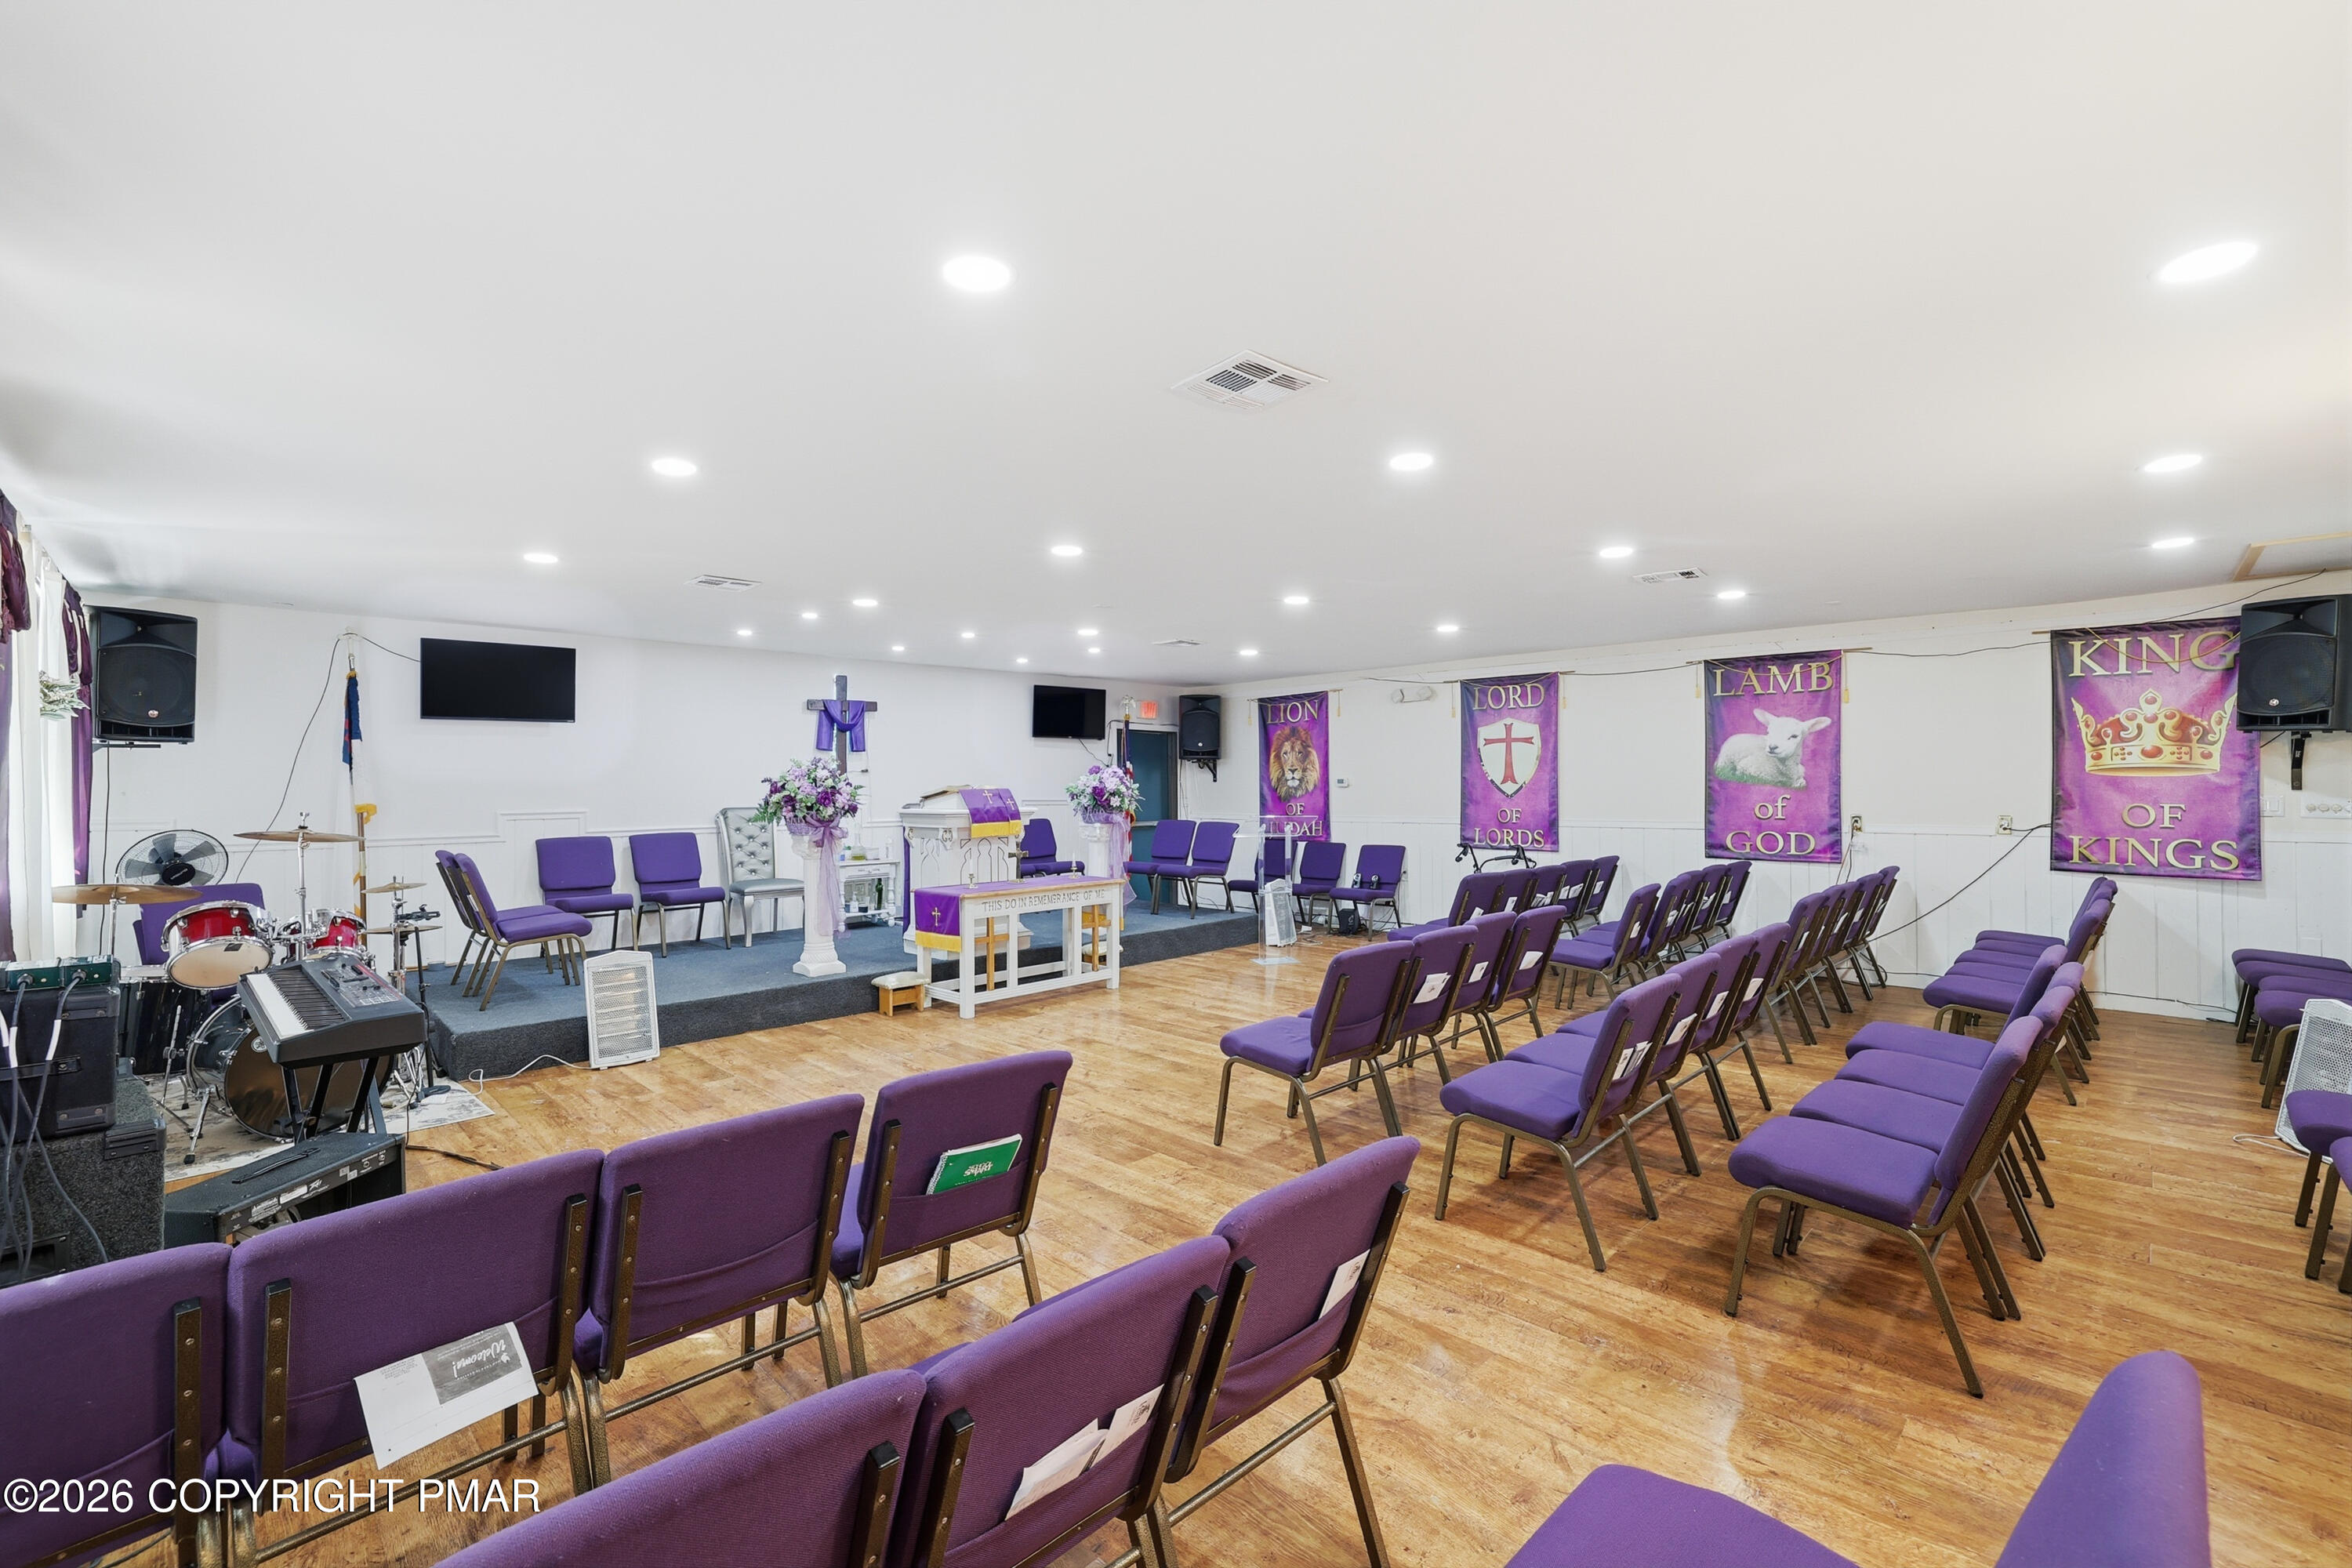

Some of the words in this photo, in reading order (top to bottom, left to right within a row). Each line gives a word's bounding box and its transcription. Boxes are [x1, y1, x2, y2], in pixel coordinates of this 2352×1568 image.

[2067, 630, 2240, 677] KING
[1713, 662, 1834, 696] LAMB
[1473, 683, 1545, 710] LORD
[1267, 699, 1319, 724] LION
[1286, 803, 1305, 815] OF
[1497, 808, 1522, 823] OF
[1754, 794, 1791, 820] of
[2122, 803, 2186, 829] OF
[1474, 828, 1544, 848] LORDS
[1726, 831, 1816, 855] GOD
[2069, 835, 2239, 870] KINGS
[982, 900, 1002, 912] THIS
[1005, 898, 1016, 909] DO
[1018, 897, 1027, 908] IN
[1029, 891, 1080, 906] REMEMBRANCE
[1083, 890, 1092, 901] OF
[1094, 889, 1105, 899] ME
